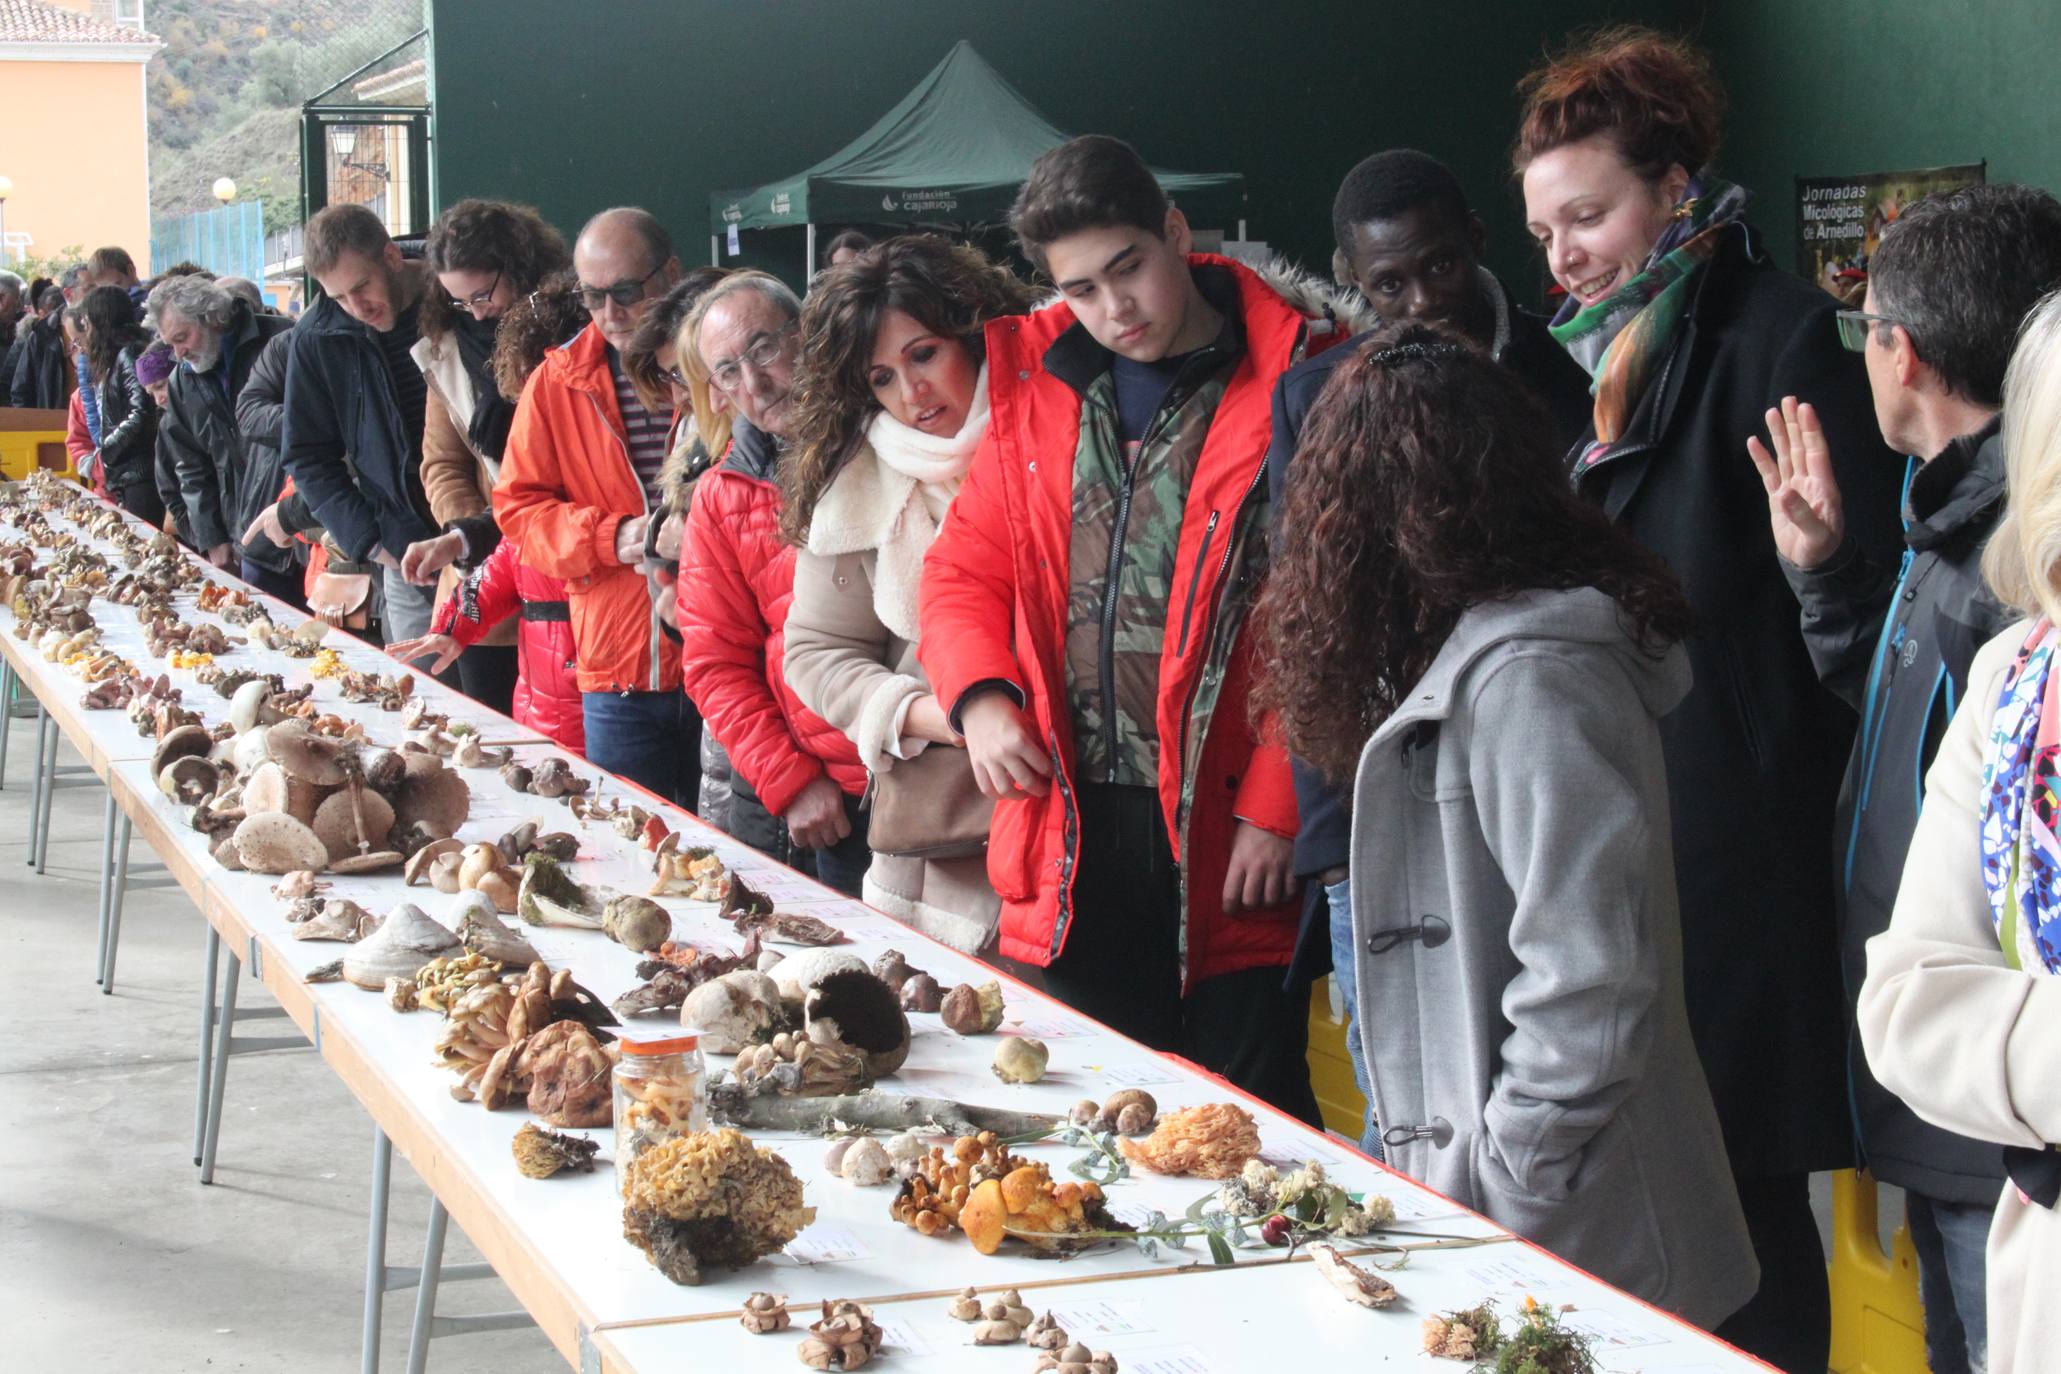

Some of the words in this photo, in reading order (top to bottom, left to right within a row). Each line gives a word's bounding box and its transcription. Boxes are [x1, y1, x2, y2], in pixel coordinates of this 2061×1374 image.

[1802, 184, 1867, 201] Jornadas
[1803, 203, 1864, 223] Micológicas
[1803, 225, 1814, 240] de
[1816, 222, 1864, 240] Arnedillo
